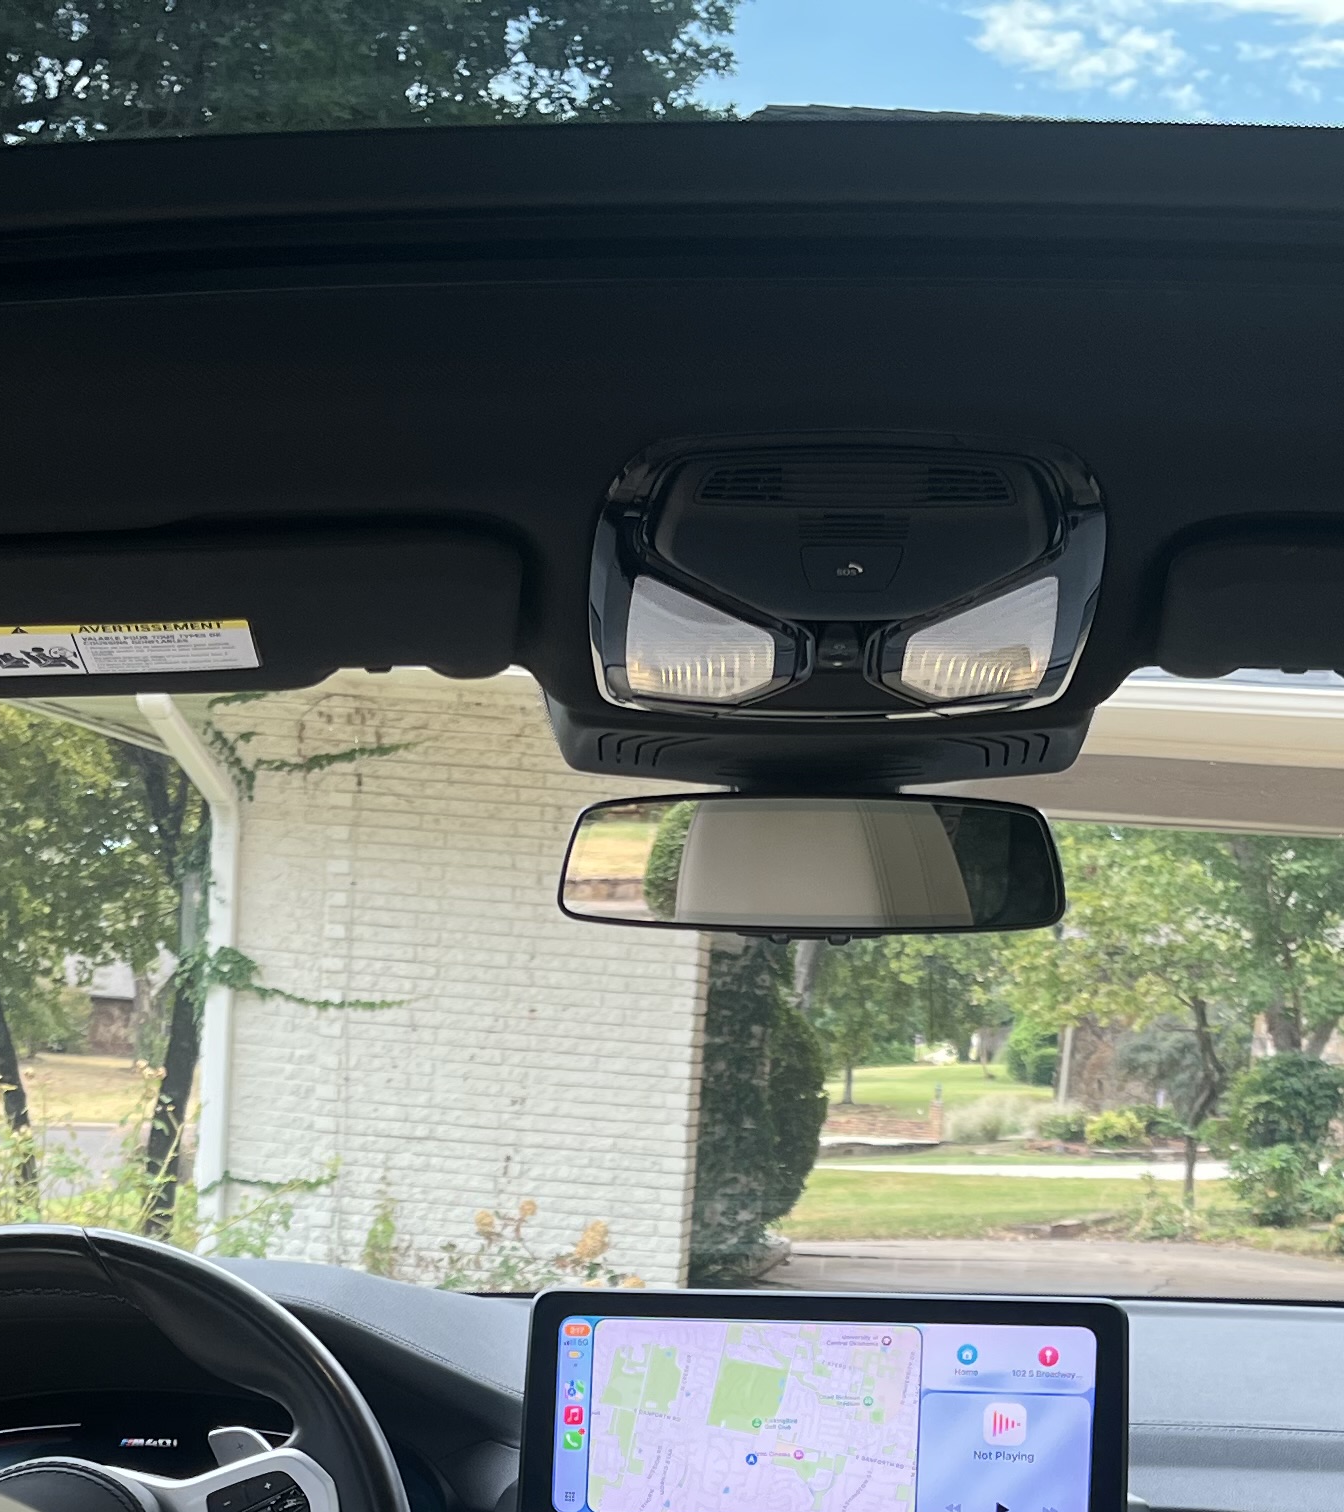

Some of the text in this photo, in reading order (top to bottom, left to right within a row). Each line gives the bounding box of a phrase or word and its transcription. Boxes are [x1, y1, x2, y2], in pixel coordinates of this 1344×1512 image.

[78, 622, 224, 634] AVERTISSEMENT
[954, 1368, 979, 1377] Home
[1011, 1369, 1027, 1378] 102
[973, 1451, 1035, 1464] Not Playing
